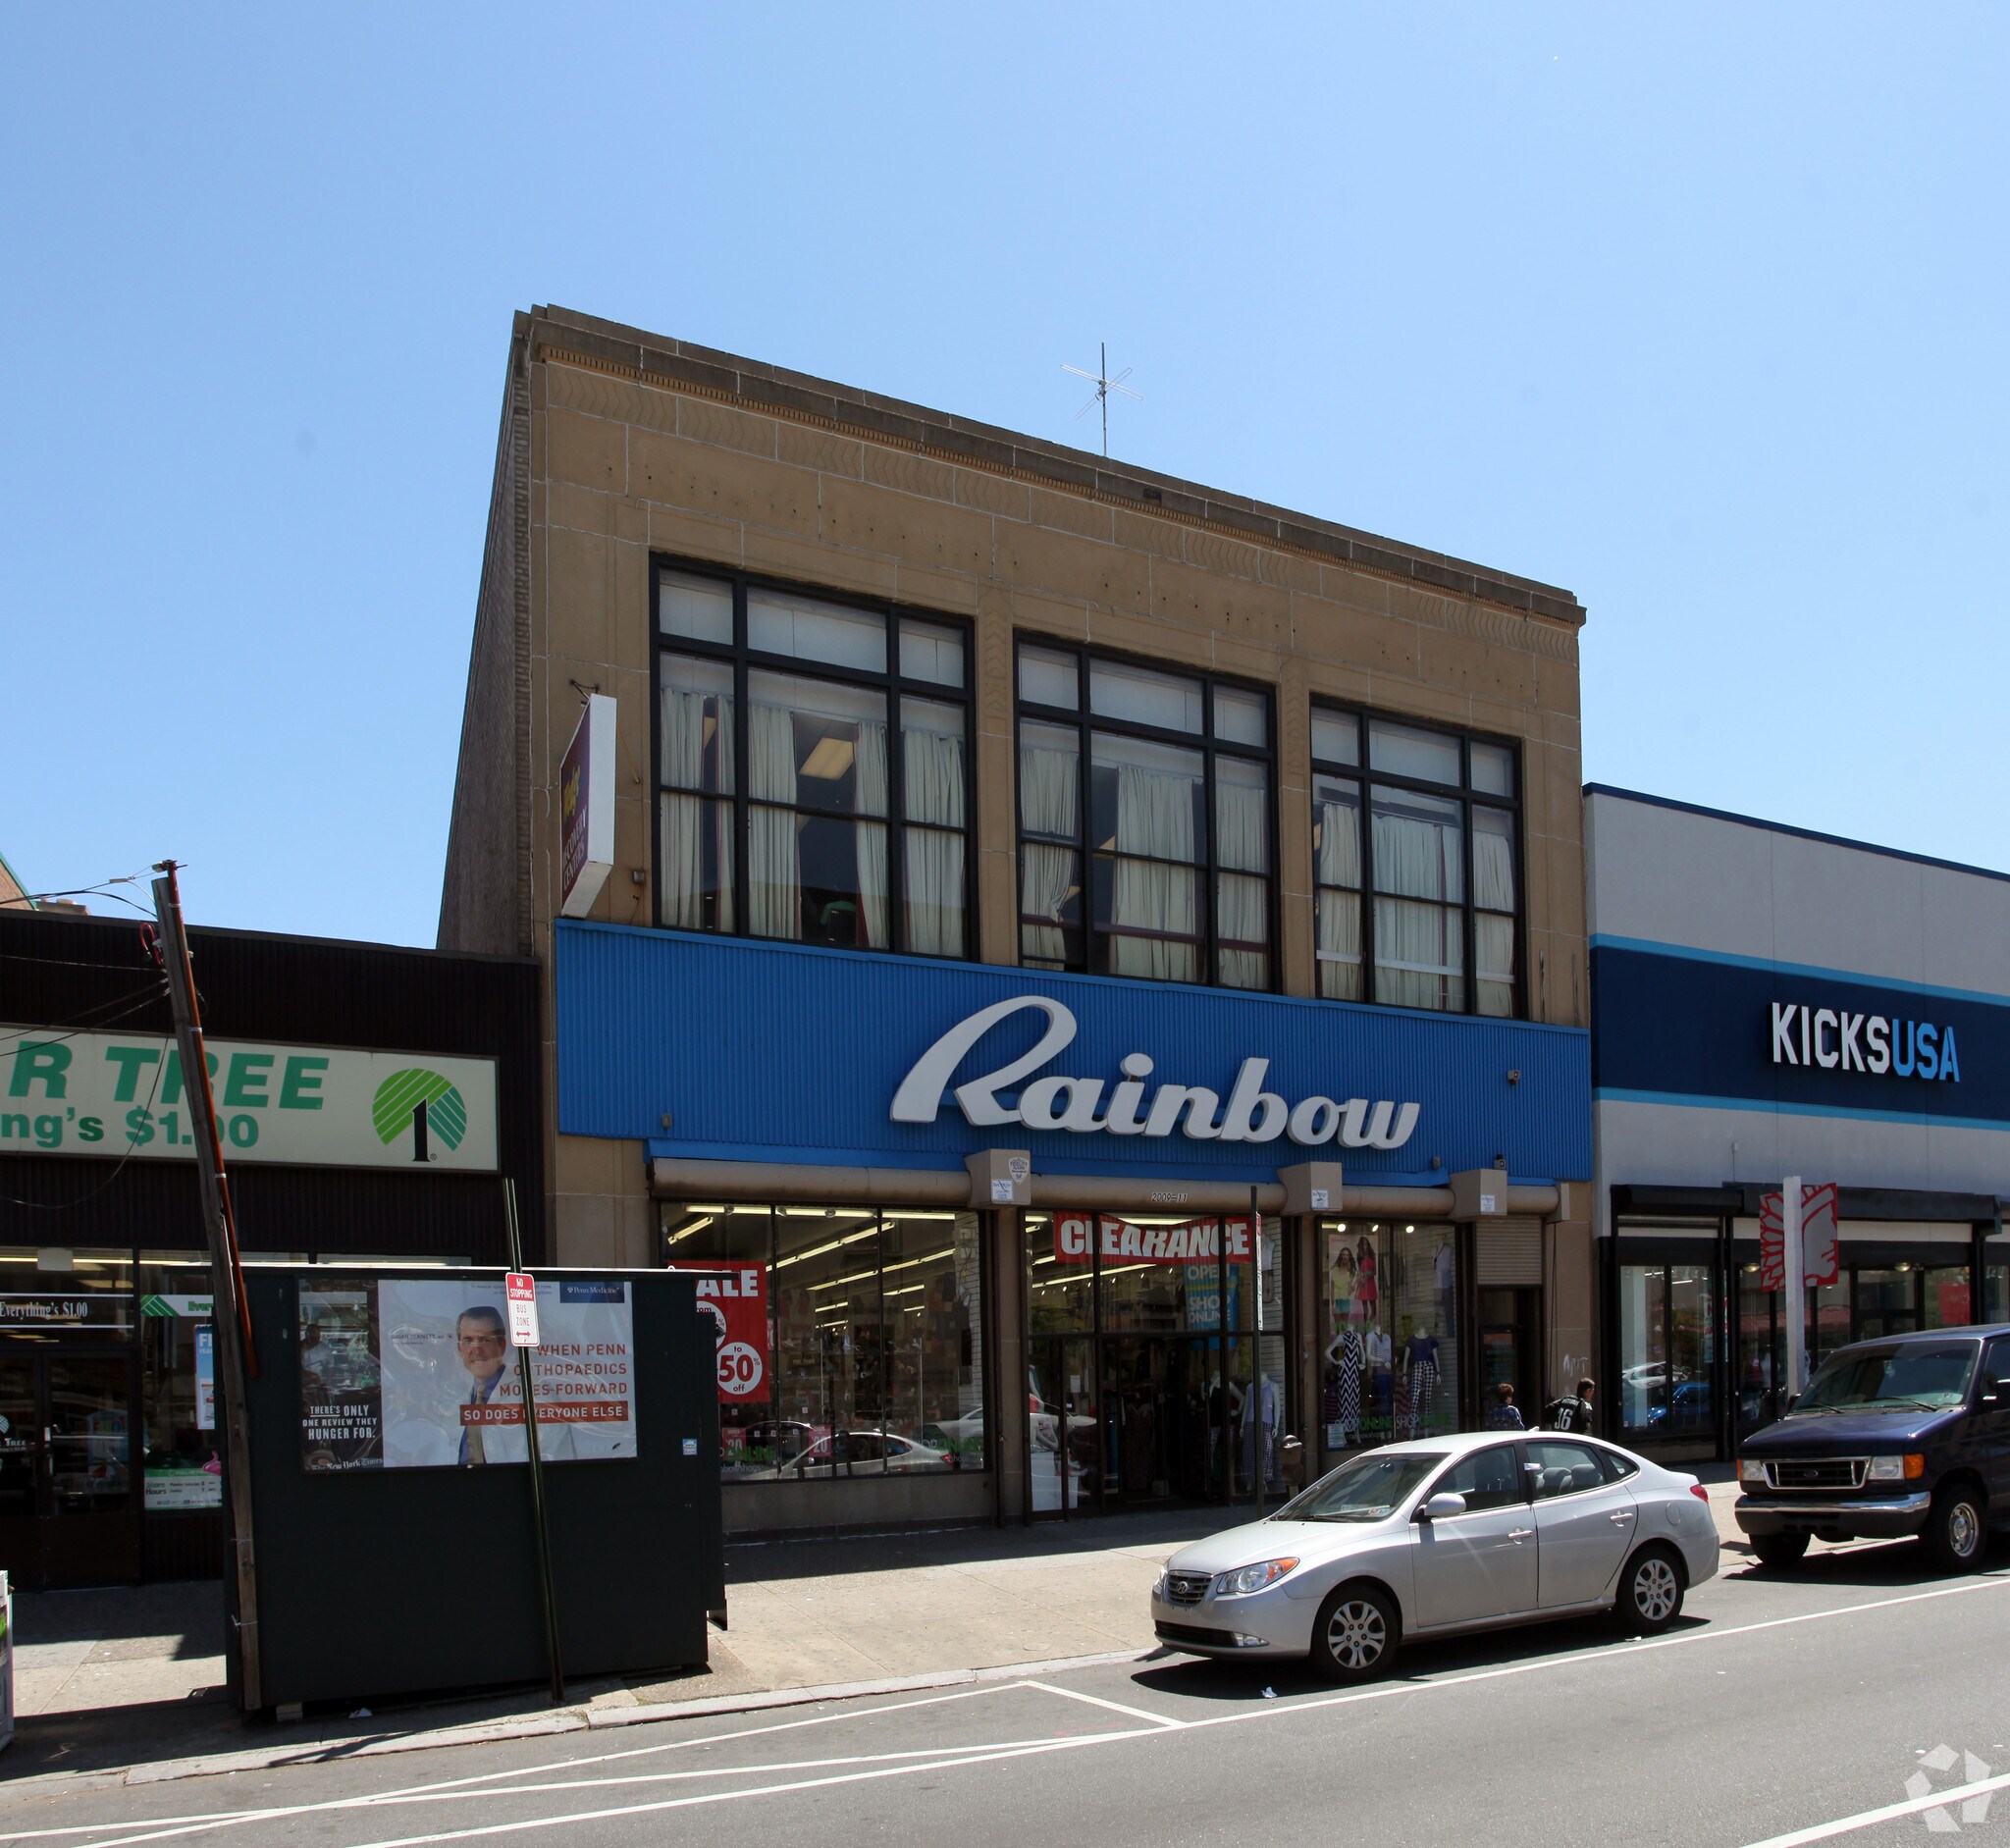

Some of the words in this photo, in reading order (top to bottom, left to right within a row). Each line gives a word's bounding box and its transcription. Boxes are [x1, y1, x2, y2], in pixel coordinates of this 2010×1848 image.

[890, 995, 1420, 1150] Rainbow
[125, 1105, 259, 1148] $1.0
[1151, 1191, 1189, 1203] 2009-11
[1060, 1219, 1249, 1258] CLEARANCE
[515, 1278, 524, 1288] NO
[696, 1269, 759, 1297] ALE
[509, 1288, 533, 1299] STOPPING
[0, 1301, 60, 1321] Everything's
[63, 1300, 88, 1318] $1.00
[516, 1303, 527, 1314] BUS
[516, 1316, 530, 1327] ZONE
[538, 1344, 581, 1356] WHEN
[587, 1344, 626, 1355] PENN
[514, 1363, 627, 1376] OTHOPAEDICS
[500, 1383, 550, 1397] MOES
[555, 1382, 628, 1396] FORWARD
[733, 1383, 745, 1392] off
[310, 1405, 341, 1415] THERE'S
[344, 1404, 369, 1416] ONLY
[463, 1410, 481, 1420] SO
[485, 1408, 519, 1420] DOES
[523, 1407, 588, 1419] ERYONE
[592, 1405, 623, 1416] ELSE
[321, 1417, 352, 1427] REVIEW
[356, 1417, 377, 1426] THEY
[308, 1427, 349, 1440] HUNGER
[353, 1426, 376, 1439] FOR.
